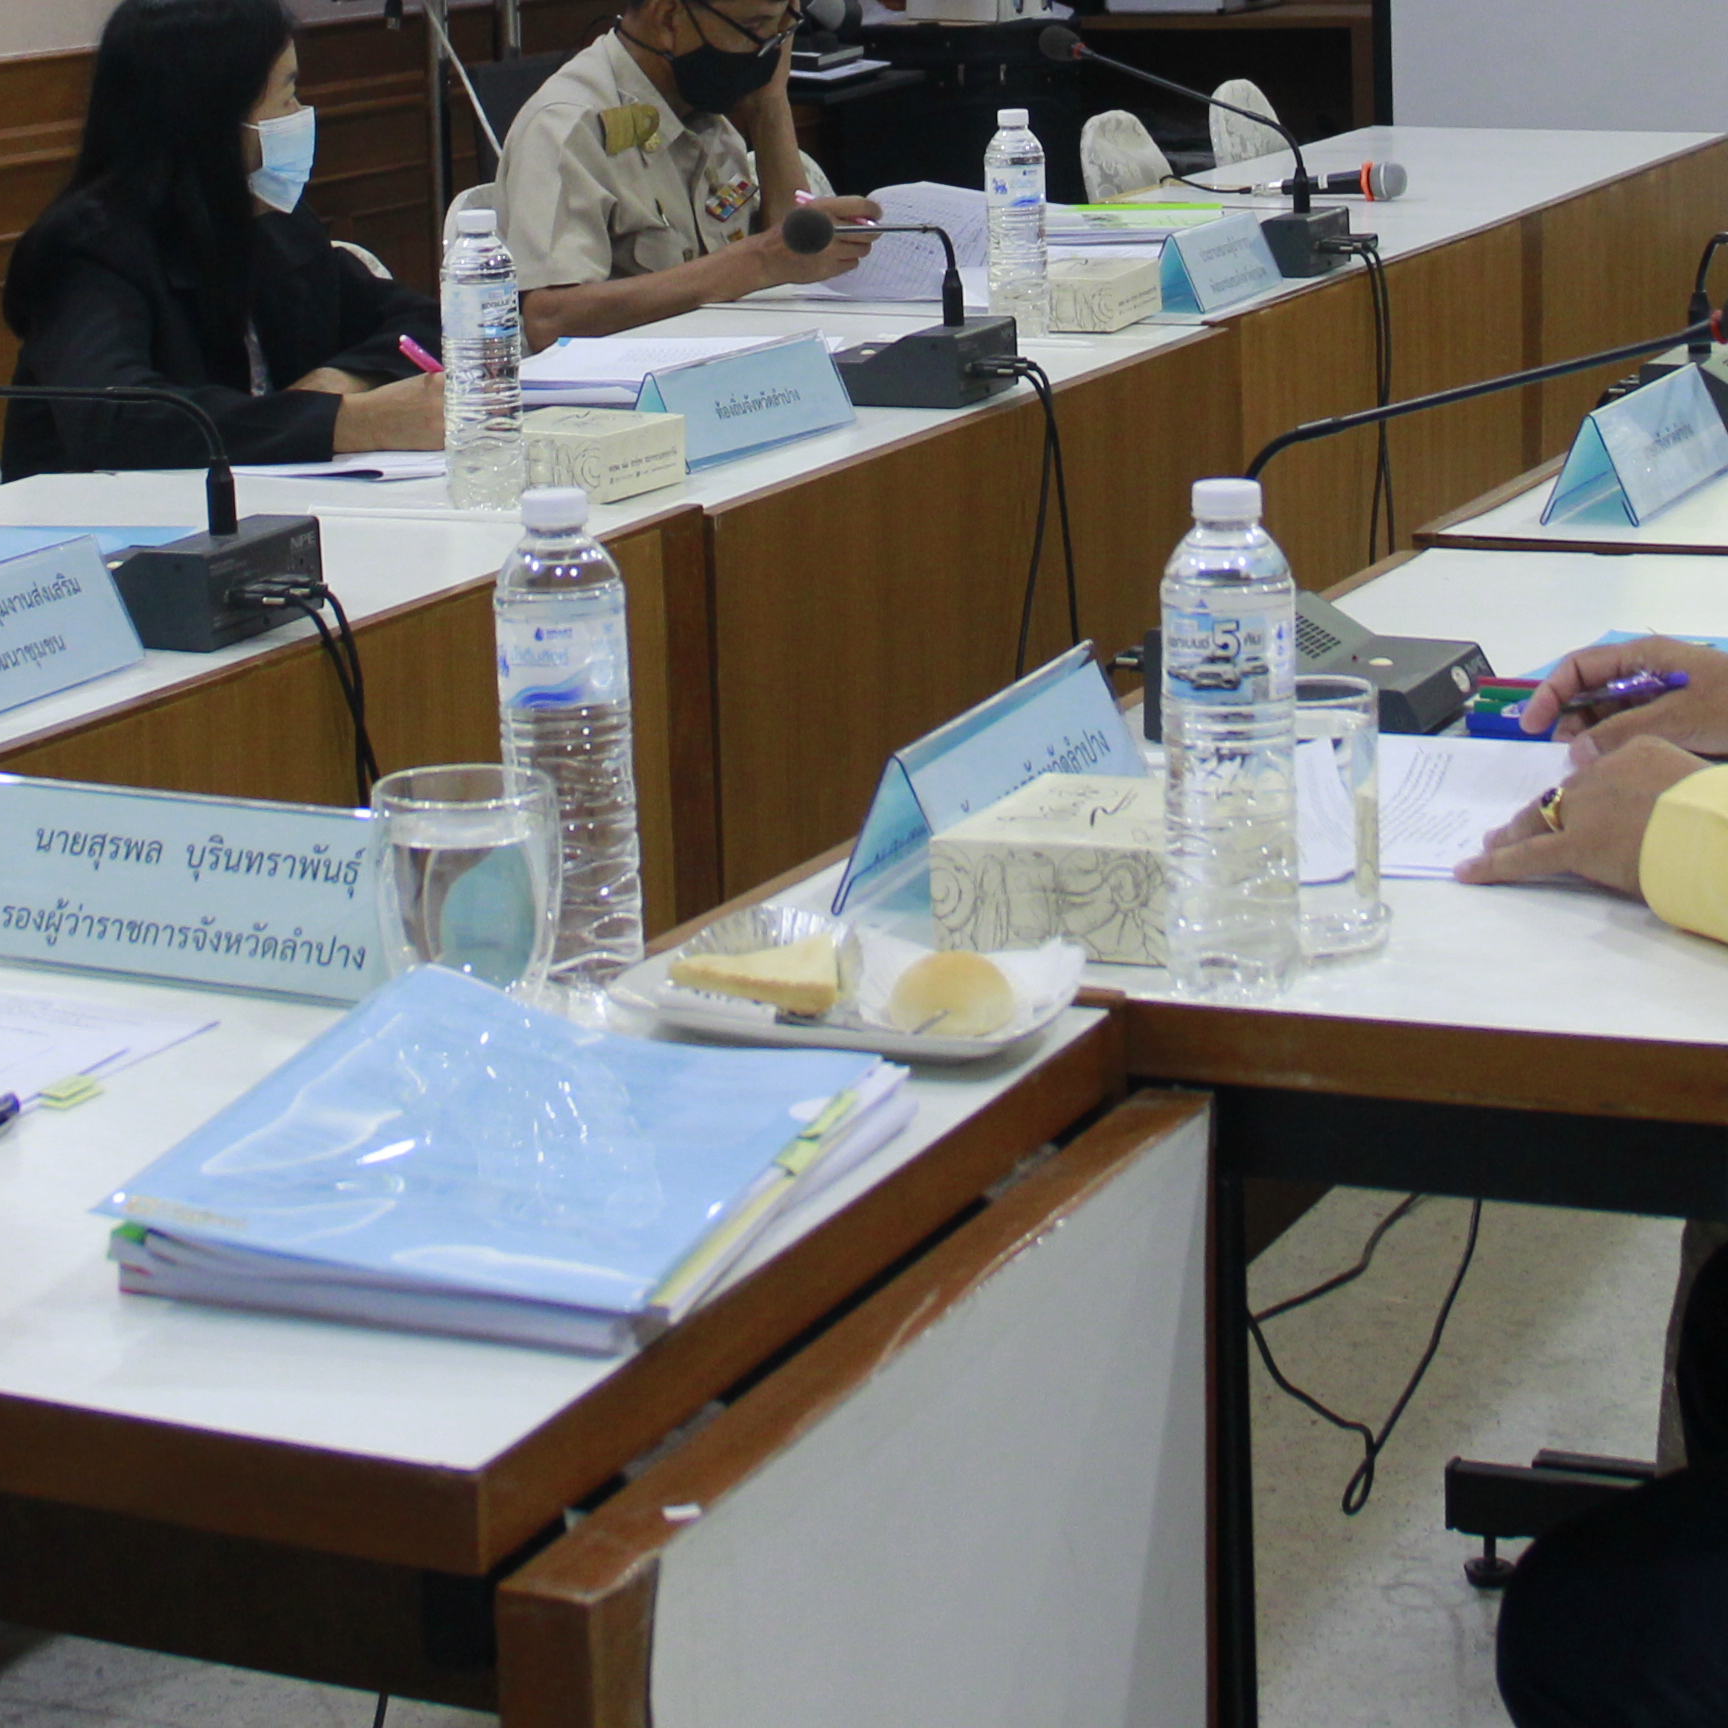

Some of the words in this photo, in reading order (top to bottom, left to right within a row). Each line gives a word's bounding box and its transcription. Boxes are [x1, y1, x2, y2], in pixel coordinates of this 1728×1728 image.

[36, 827, 164, 871] นายสุรพล
[186, 834, 365, 899] บุรินทราพันธุ์
[2, 898, 366, 971] รองผู้ว่าราชการจังหวัดลำปาง
